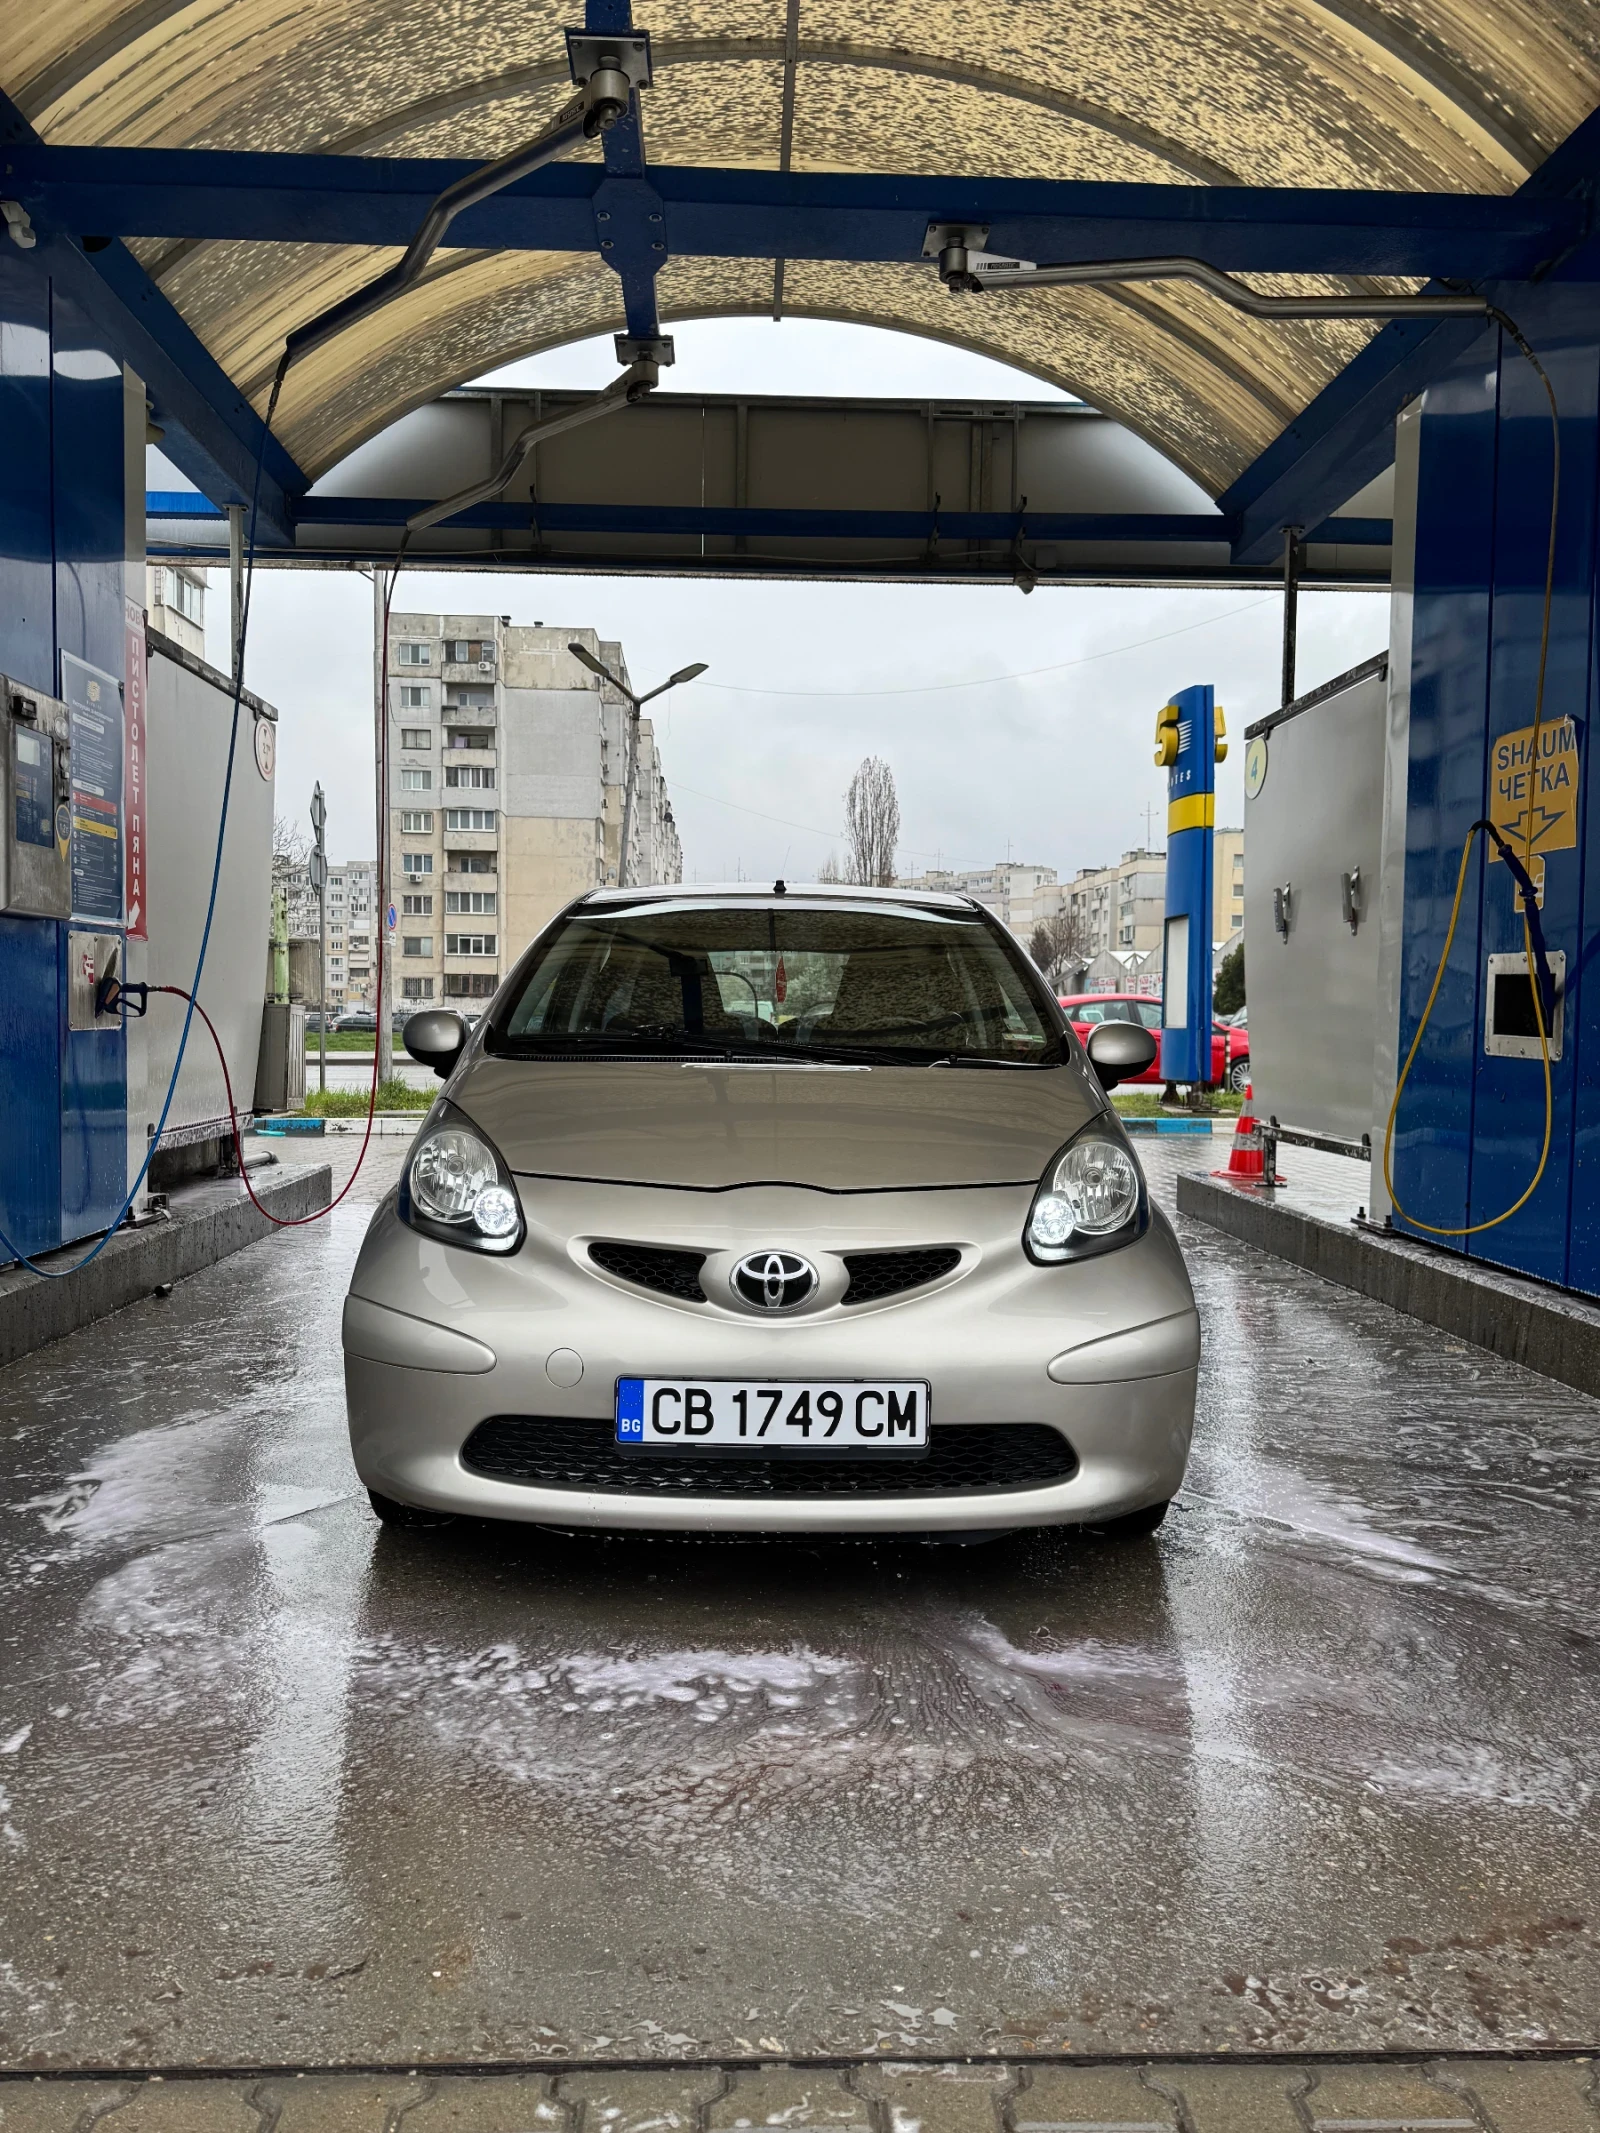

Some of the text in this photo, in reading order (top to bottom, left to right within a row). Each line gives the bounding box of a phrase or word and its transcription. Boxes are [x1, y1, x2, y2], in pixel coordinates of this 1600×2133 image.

[1154, 704, 1179, 767] 5
[1497, 724, 1575, 770] SHAUM
[131, 636, 140, 896] ПИСТОЛЕТ ПЯНА
[1251, 755, 1258, 781] 4
[621, 1418, 641, 1433] BG
[652, 1387, 917, 1438] CB 1749 CM
